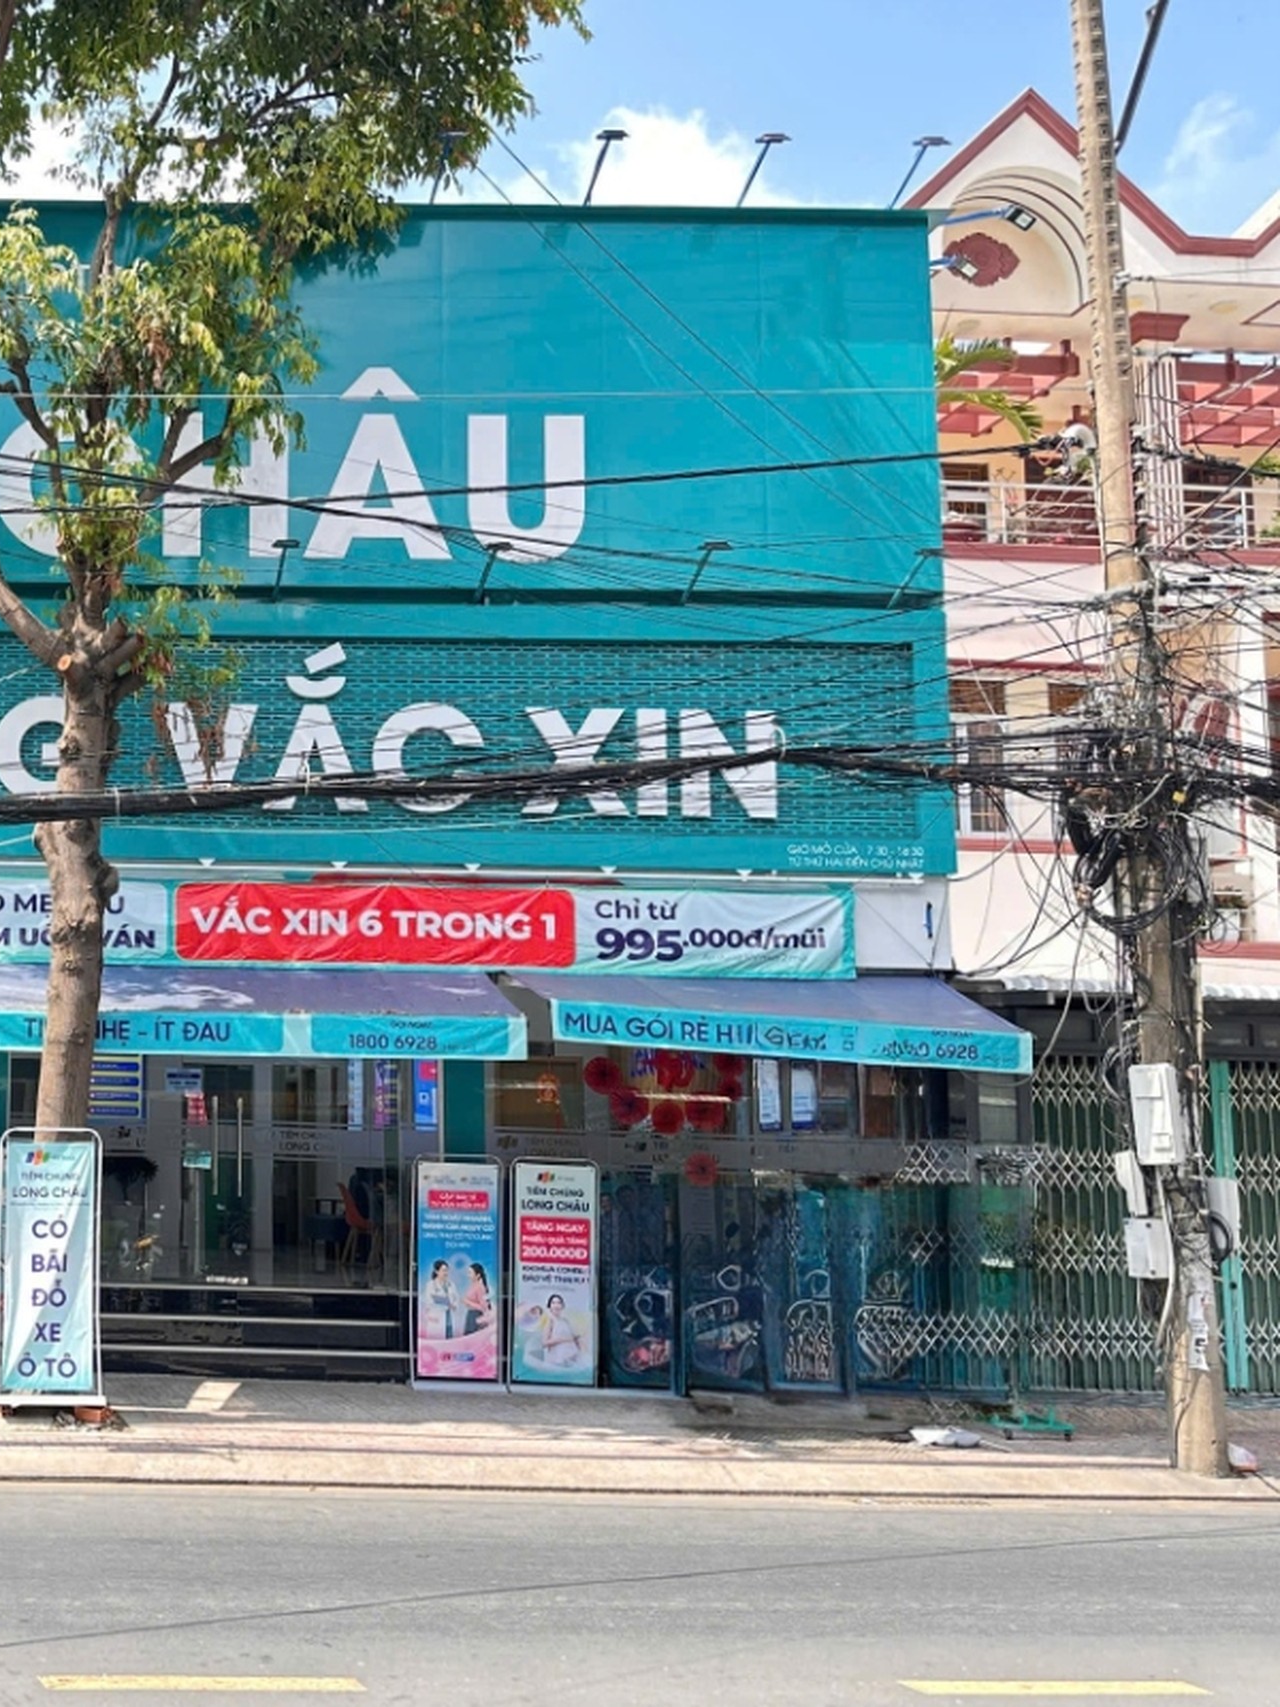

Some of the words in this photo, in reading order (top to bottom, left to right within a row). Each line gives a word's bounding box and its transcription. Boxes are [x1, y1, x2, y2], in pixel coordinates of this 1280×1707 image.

[164, 641, 485, 813] VẮC
[524, 706, 779, 819] XIN
[190, 896, 272, 935] VẮC
[280, 907, 350, 937] XIN
[358, 908, 384, 937] 6
[390, 909, 533, 941] TRONG
[539, 912, 557, 941] 1
[595, 896, 641, 920] Chỉ
[646, 900, 680, 921] từ
[595, 926, 828, 962] 995.000đ/mũi
[94, 1020, 131, 1047] HẸ
[154, 1014, 175, 1042] ÍT
[182, 1020, 231, 1042] ĐAU
[563, 1012, 618, 1035] MUA
[625, 1011, 674, 1041] GÓI
[348, 1033, 389, 1049] 1800
[394, 1035, 438, 1051] 6928
[934, 1044, 980, 1062] 6928
[12, 1185, 49, 1198] LONG
[521, 1199, 554, 1211] LONG
[556, 1199, 590, 1212] CHÂU
[31, 1214, 68, 1239] CÓ
[31, 1248, 68, 1273] BÃI
[31, 1278, 67, 1308] ĐỖ
[34, 1322, 62, 1343] XE
[17, 1353, 37, 1378] Ô
[43, 1352, 78, 1379] TÔ
